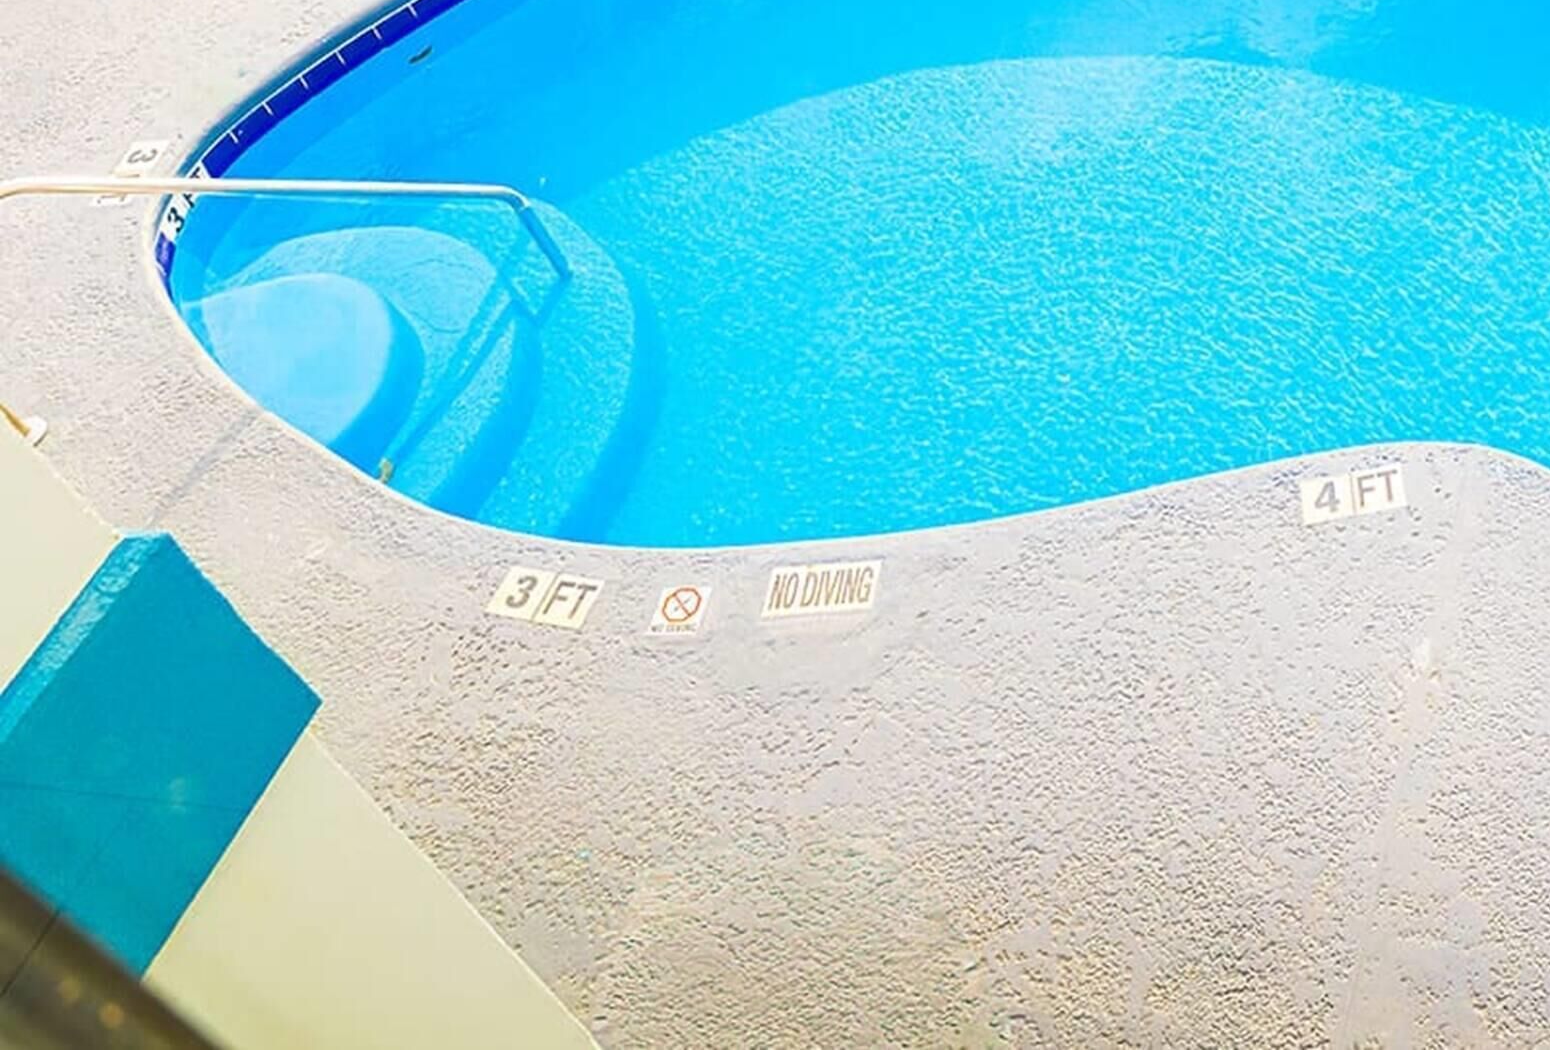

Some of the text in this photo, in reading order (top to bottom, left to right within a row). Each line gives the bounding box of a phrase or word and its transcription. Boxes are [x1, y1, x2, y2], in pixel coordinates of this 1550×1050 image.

[127, 149, 158, 164] 3
[167, 207, 185, 233] 3
[1314, 469, 1398, 512] 4 FT
[506, 576, 598, 619] 3 FT
[768, 566, 874, 610] NO DIVING
